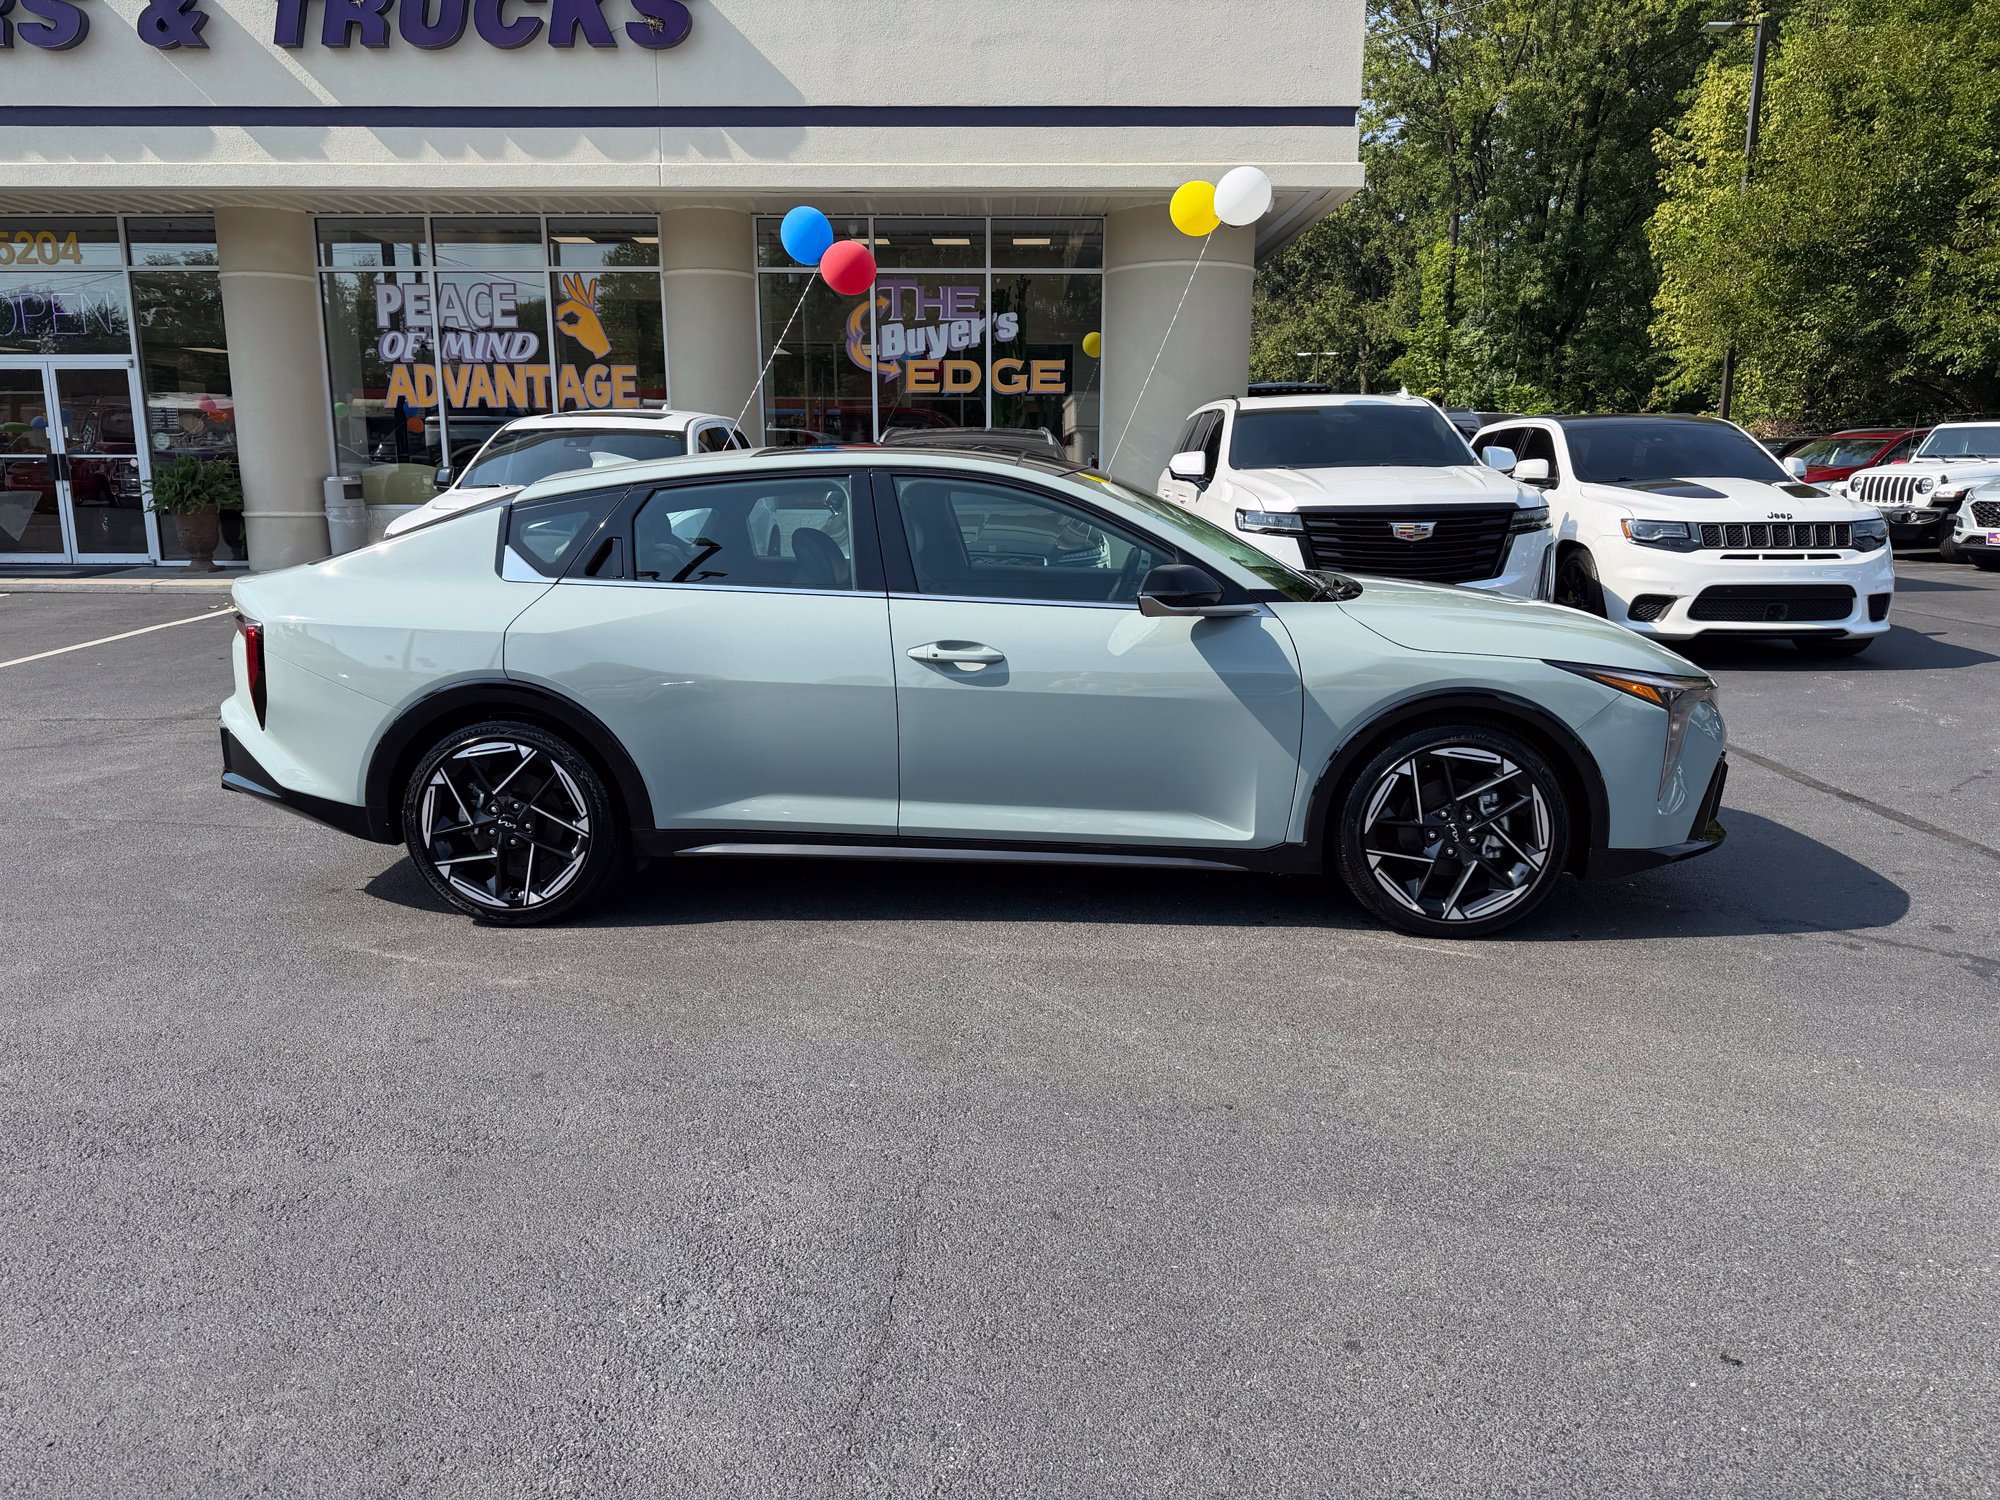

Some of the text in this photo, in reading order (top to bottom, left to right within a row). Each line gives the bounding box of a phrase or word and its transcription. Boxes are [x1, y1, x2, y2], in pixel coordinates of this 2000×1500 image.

[137, 0, 210, 49] &
[274, 0, 692, 50] TRUCKS
[375, 282, 519, 330] PEACE
[876, 278, 980, 322] THE
[378, 331, 540, 363] OF MIND
[384, 363, 641, 409] ADVANTAGE
[905, 357, 1066, 395] EDGE
[1766, 511, 1793, 521] Jeep
